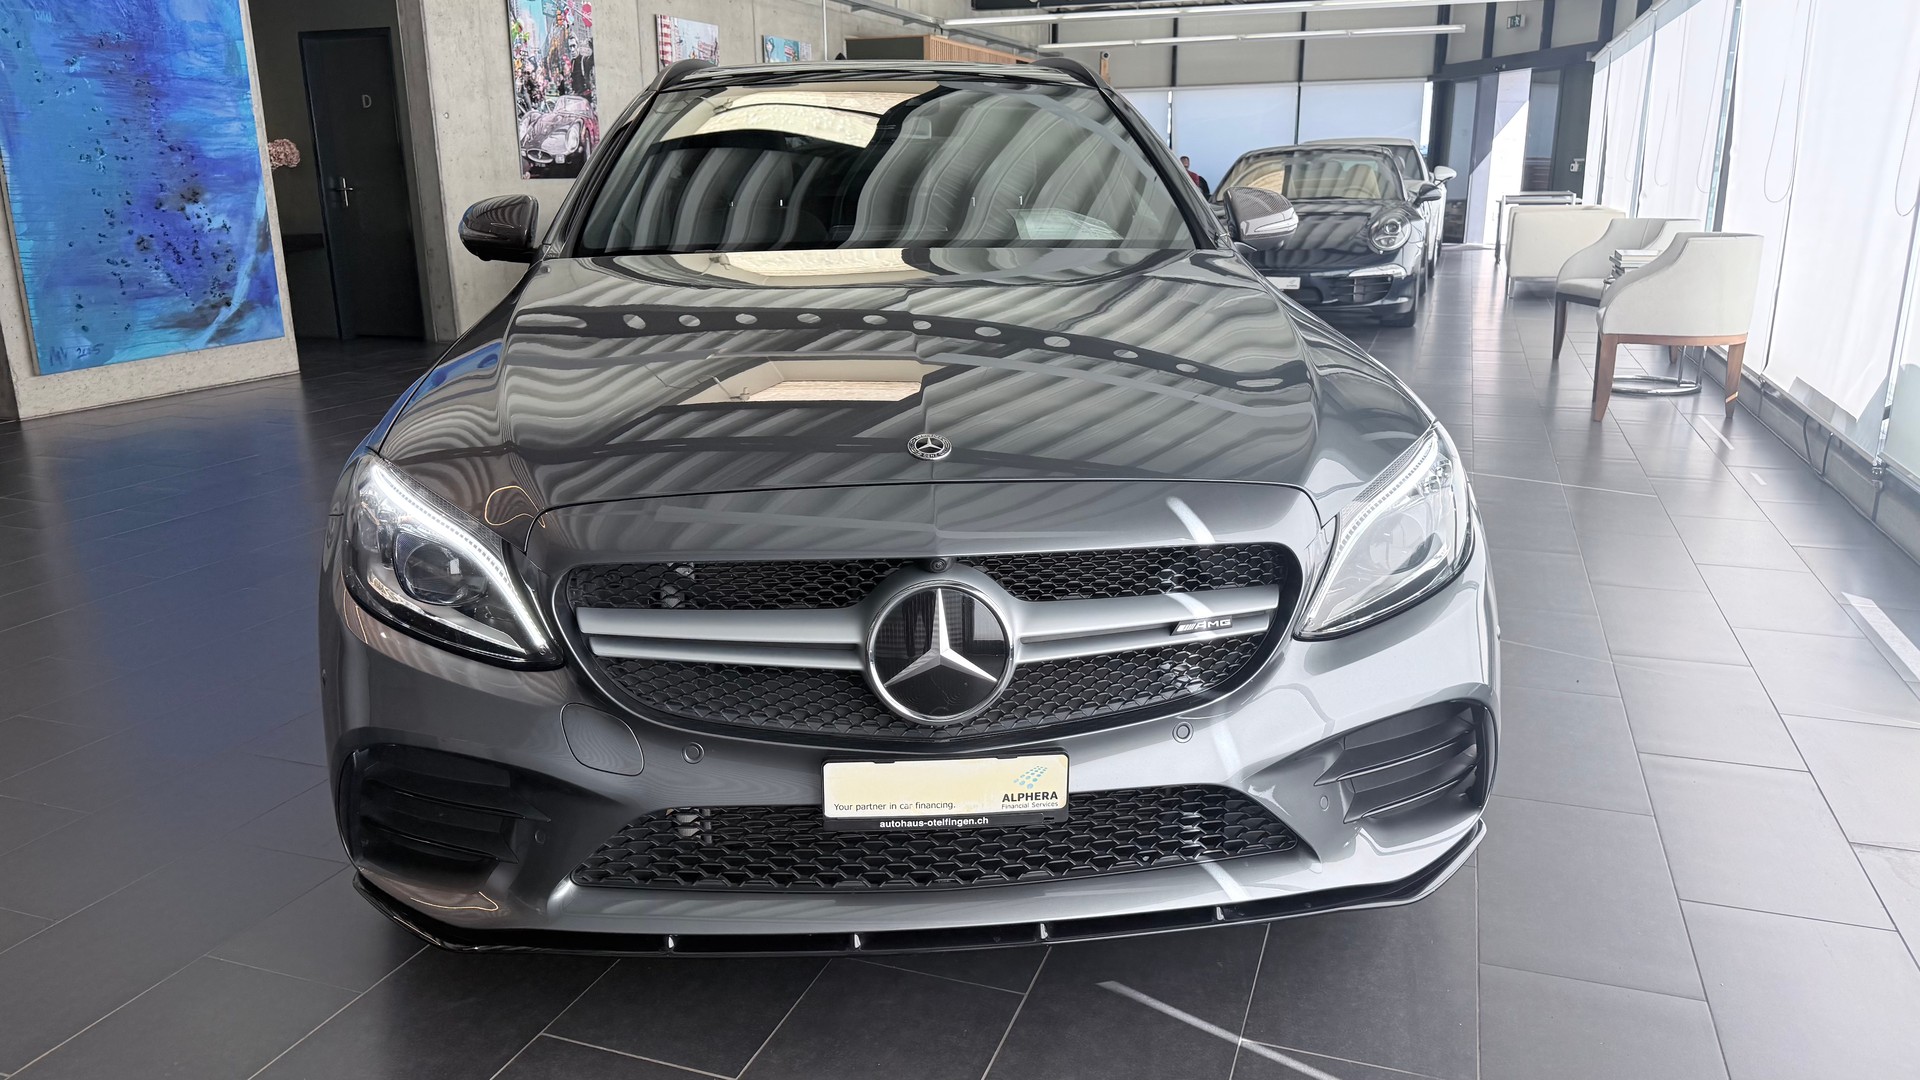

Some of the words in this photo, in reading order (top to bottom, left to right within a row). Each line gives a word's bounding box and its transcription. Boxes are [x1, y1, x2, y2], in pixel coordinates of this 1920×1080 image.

[362, 94, 372, 108] D
[1194, 618, 1232, 630] AMG
[1002, 791, 1058, 802] ALPHERA
[834, 803, 853, 811] Your
[855, 802, 887, 811] partner
[889, 802, 897, 810] in
[915, 801, 956, 811] financing.
[1001, 802, 1030, 810] Financial
[879, 817, 989, 828] autohaus-otelfingen.ch
